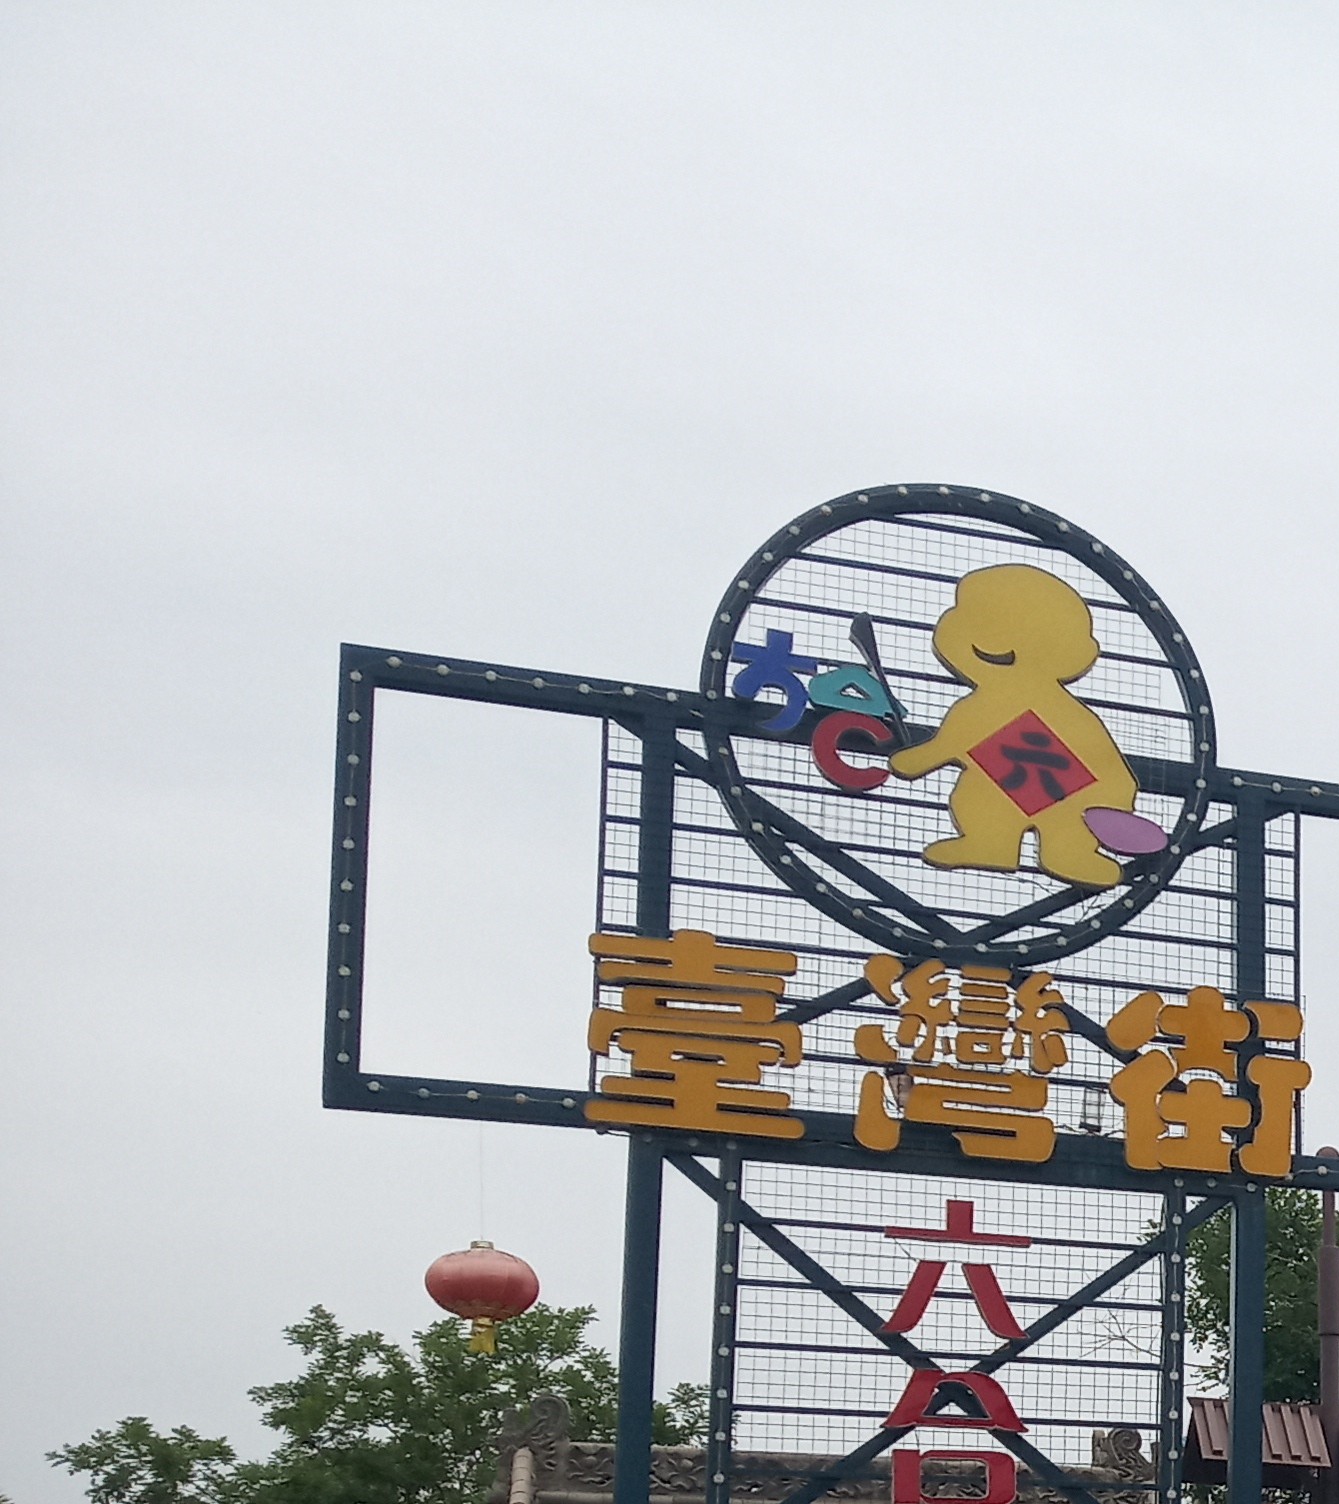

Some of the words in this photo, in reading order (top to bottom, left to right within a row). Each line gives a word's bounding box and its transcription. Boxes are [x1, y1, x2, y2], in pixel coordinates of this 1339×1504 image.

[1000, 731, 1070, 800] 六
[584, 928, 1312, 1178] 臺灣街
